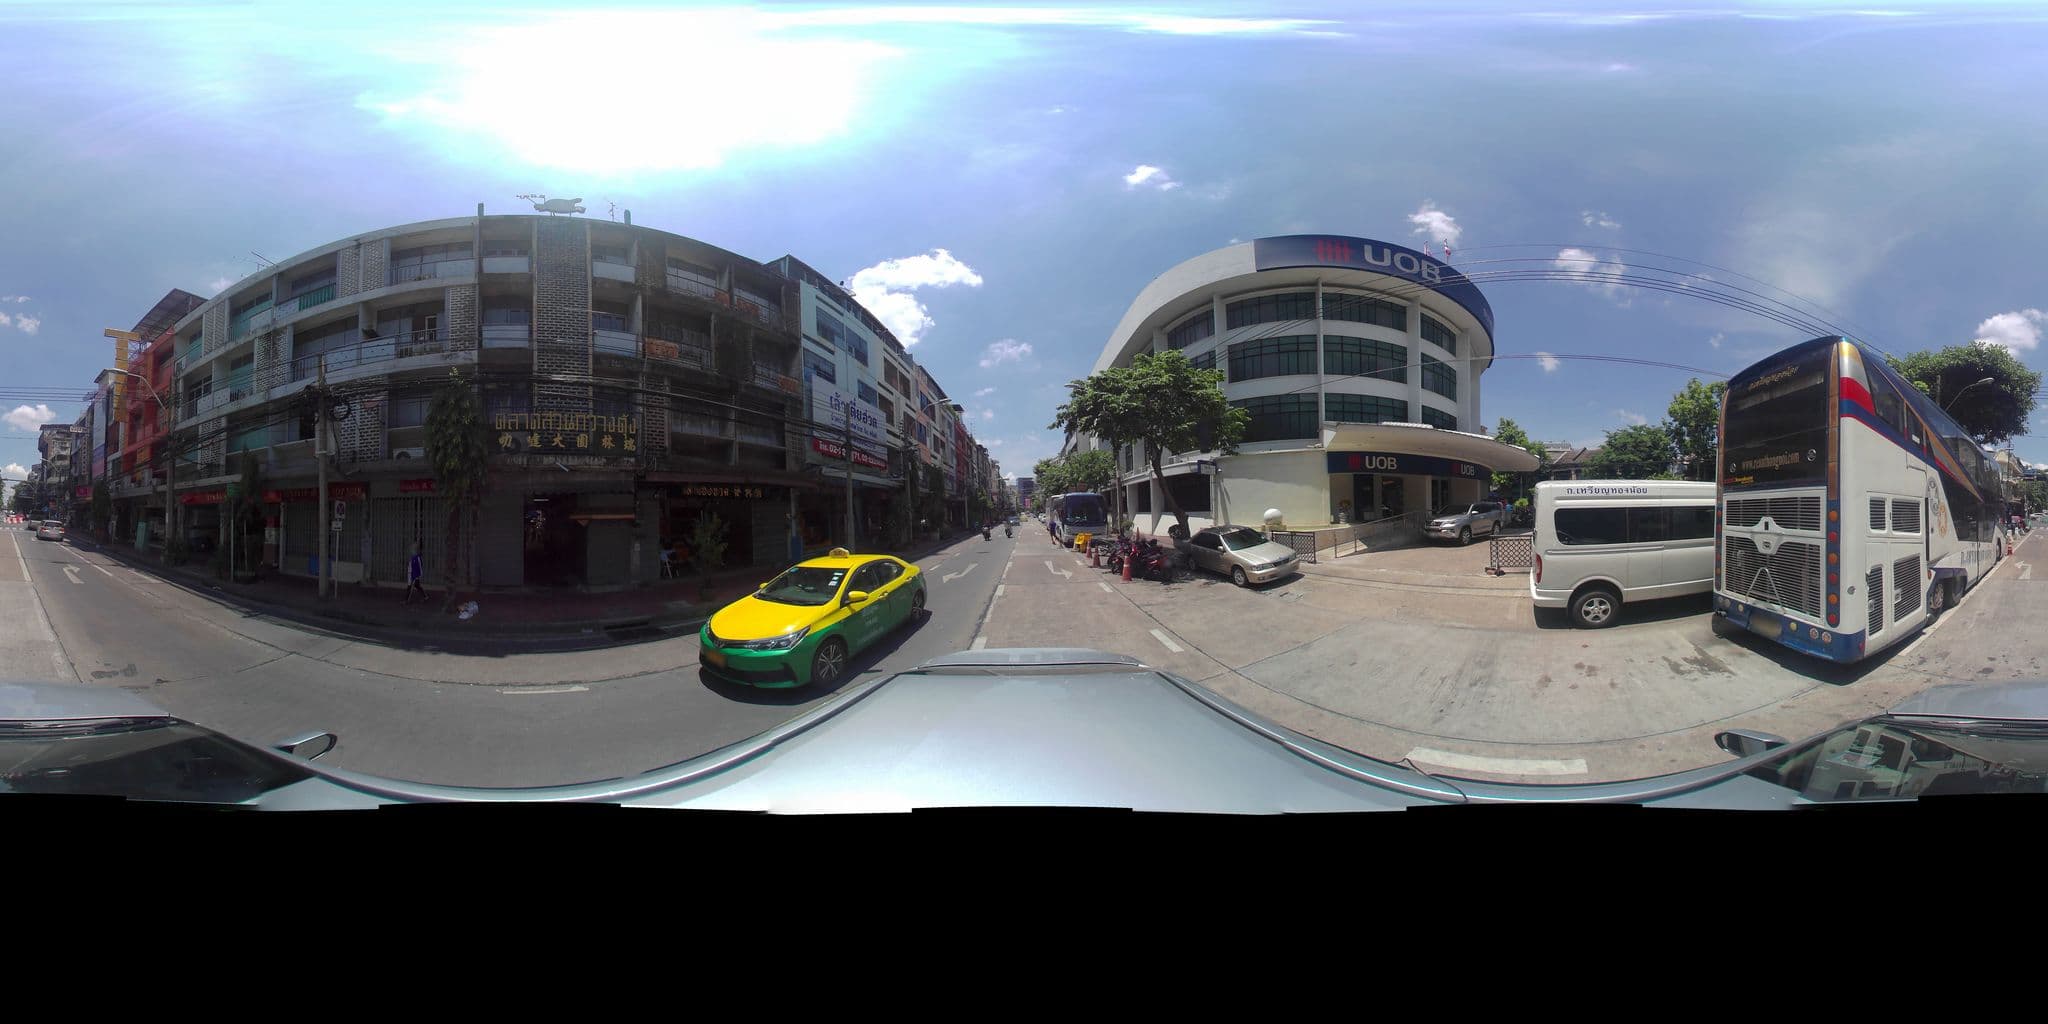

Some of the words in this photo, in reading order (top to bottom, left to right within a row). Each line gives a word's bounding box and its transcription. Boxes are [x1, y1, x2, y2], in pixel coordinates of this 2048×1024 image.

[1364, 244, 1441, 284] UOB
[1365, 456, 1397, 470] UOB
[1461, 464, 1475, 476] UOB
